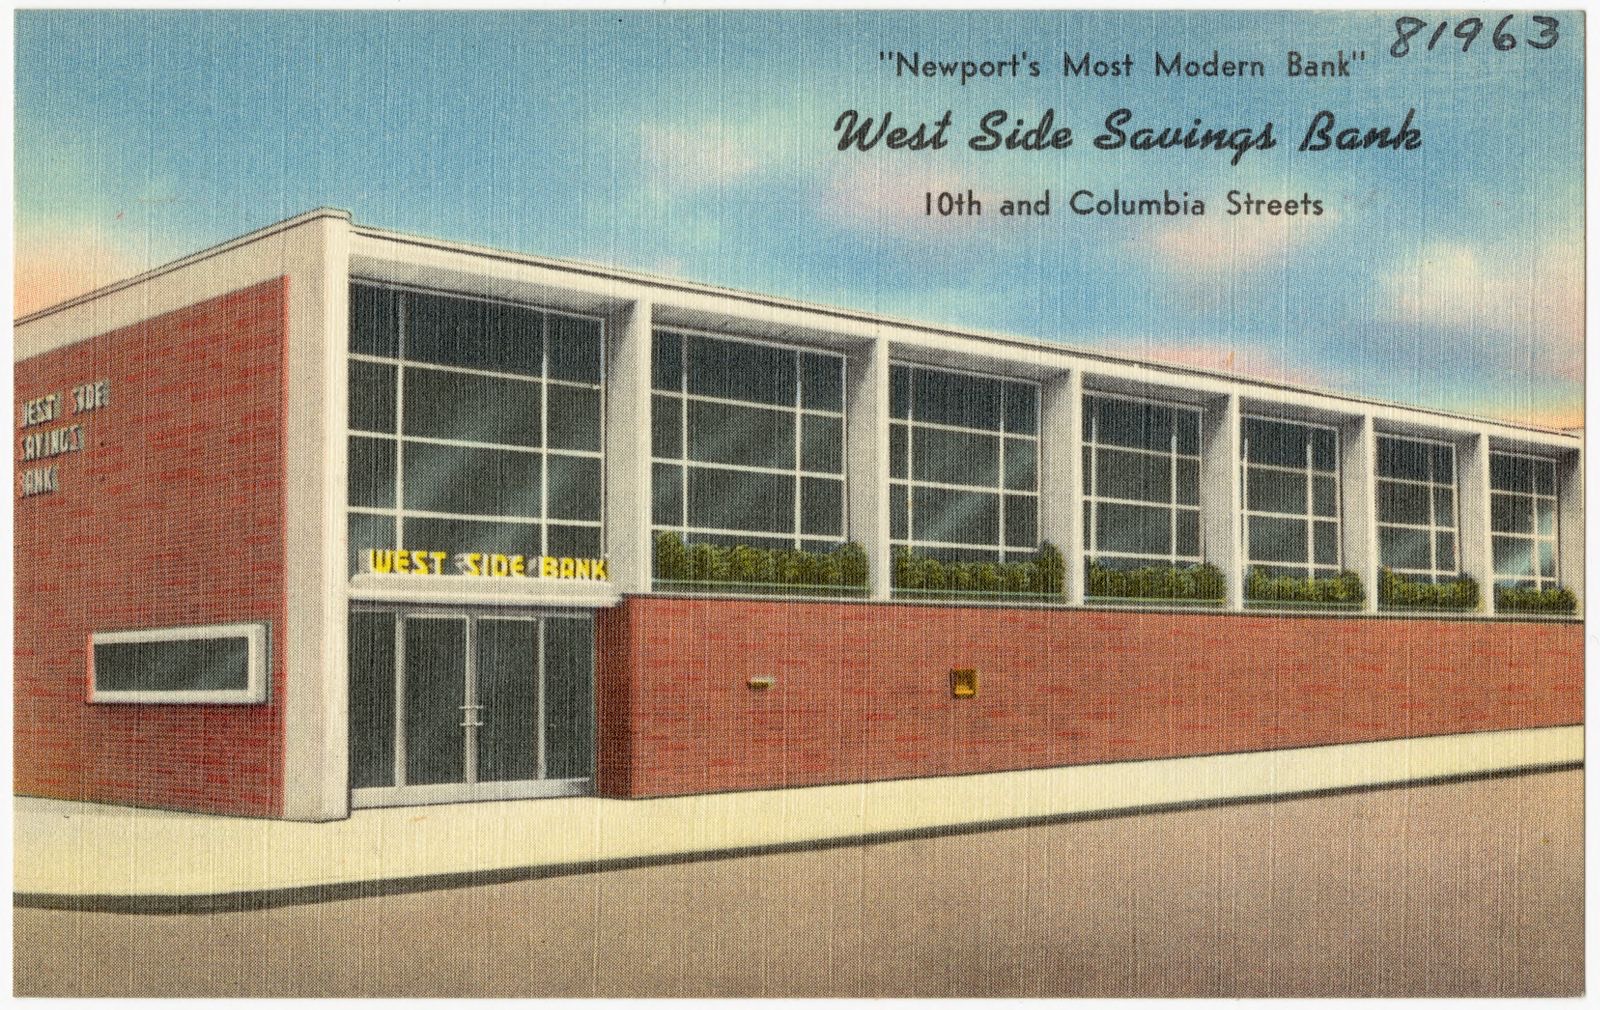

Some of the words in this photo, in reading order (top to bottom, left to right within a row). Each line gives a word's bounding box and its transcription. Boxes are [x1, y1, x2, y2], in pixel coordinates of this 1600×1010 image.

[1390, 14, 1560, 58] 81963
[879, 51, 1041, 85] "Newport's
[1062, 51, 1134, 77] Most
[1155, 50, 1265, 77] Modern
[1287, 50, 1366, 77] Bank"
[833, 109, 952, 151] West
[968, 108, 1073, 151] Side
[1093, 108, 1277, 166] Savings
[1299, 108, 1423, 151] Bank
[925, 190, 982, 216] 10th
[999, 189, 1051, 216] and
[1069, 189, 1206, 216] Columbia
[1226, 189, 1324, 216] Streets
[370, 549, 446, 575] WEST
[466, 552, 526, 577] SIDE
[541, 556, 608, 580] BANK
